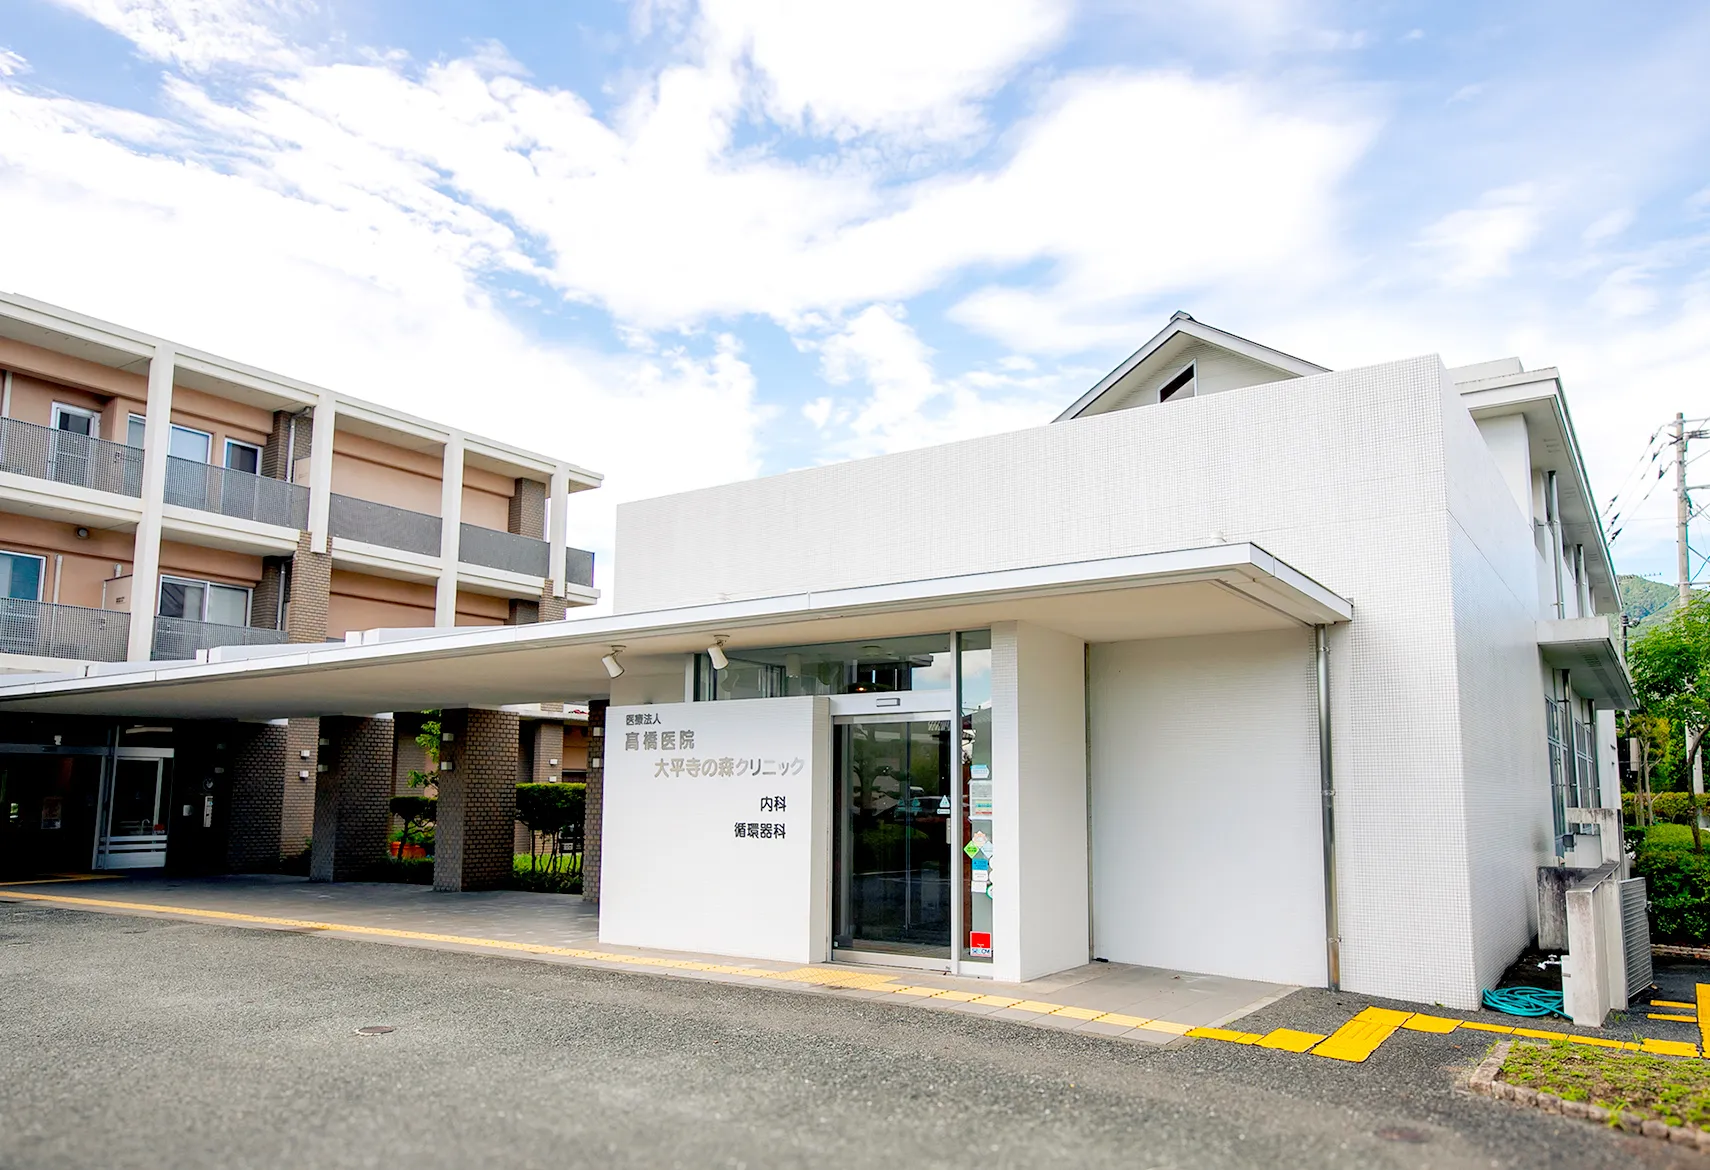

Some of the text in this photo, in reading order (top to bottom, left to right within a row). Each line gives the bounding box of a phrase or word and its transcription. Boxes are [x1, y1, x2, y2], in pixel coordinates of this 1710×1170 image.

[626, 713, 661, 725] 医療法人
[654, 756, 805, 778] 大平寺の森クリニック
[760, 796, 786, 812] 内科
[734, 822, 786, 839] 循環器科
